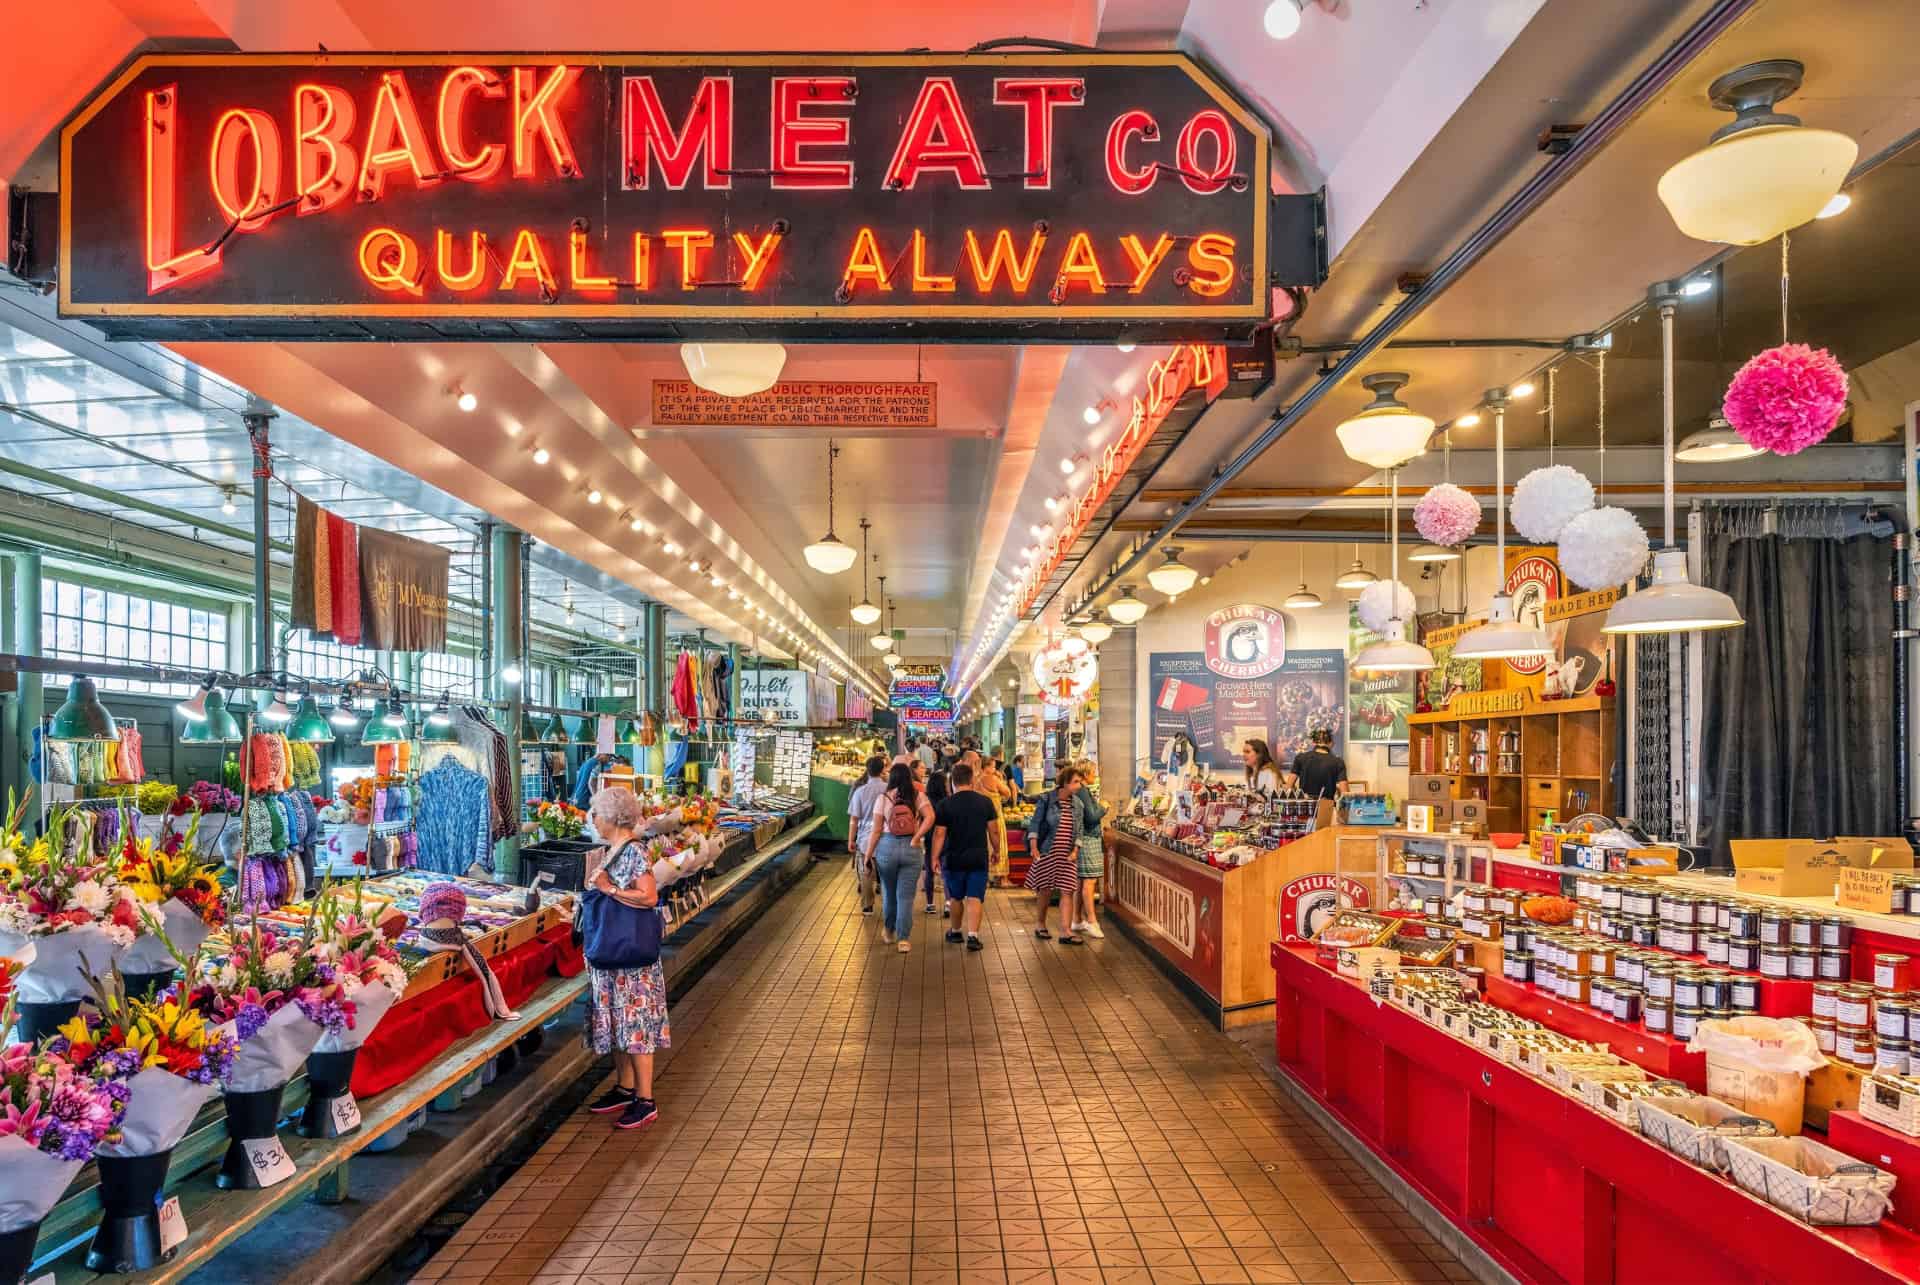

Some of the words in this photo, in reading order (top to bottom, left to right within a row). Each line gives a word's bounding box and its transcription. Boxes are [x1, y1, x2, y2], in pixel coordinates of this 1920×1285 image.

[621, 76, 1086, 190] MEAT
[358, 227, 783, 298] QUALITY
[846, 226, 1236, 297] ALWAYS
[657, 383, 689, 394] THIS
[770, 384, 812, 395] UBLIC
[818, 384, 929, 396] THOROUGHFARE
[659, 404, 675, 412] OF
[681, 404, 700, 412] THE
[705, 404, 732, 412] PIKE
[738, 405, 776, 413] PLACE
[781, 405, 821, 413] PUBLIC
[825, 405, 866, 413] MARKET
[889, 406, 909, 414] AND
[910, 406, 929, 414] THE
[776, 396, 834, 405] RESERVED
[839, 396, 861, 405] FOR
[863, 397, 882, 405] THE
[886, 397, 930, 406] PATRONS
[706, 413, 768, 422] INVESTMENT
[791, 413, 810, 422] AND
[813, 413, 839, 422] THEIR
[843, 414, 889, 423] RESPECTIVE
[892, 414, 929, 423] TENANTS
[1506, 560, 1554, 596] CHUKAR
[1549, 599, 1583, 617] MADE
[1587, 590, 1624, 608] HERE
[1209, 606, 1278, 627] CHUKAR
[1209, 656, 1280, 677] CHERRIES
[743, 697, 779, 708] RUITS
[911, 710, 951, 719] SEAFOOD
[1286, 876, 1363, 899] CHUKAR
